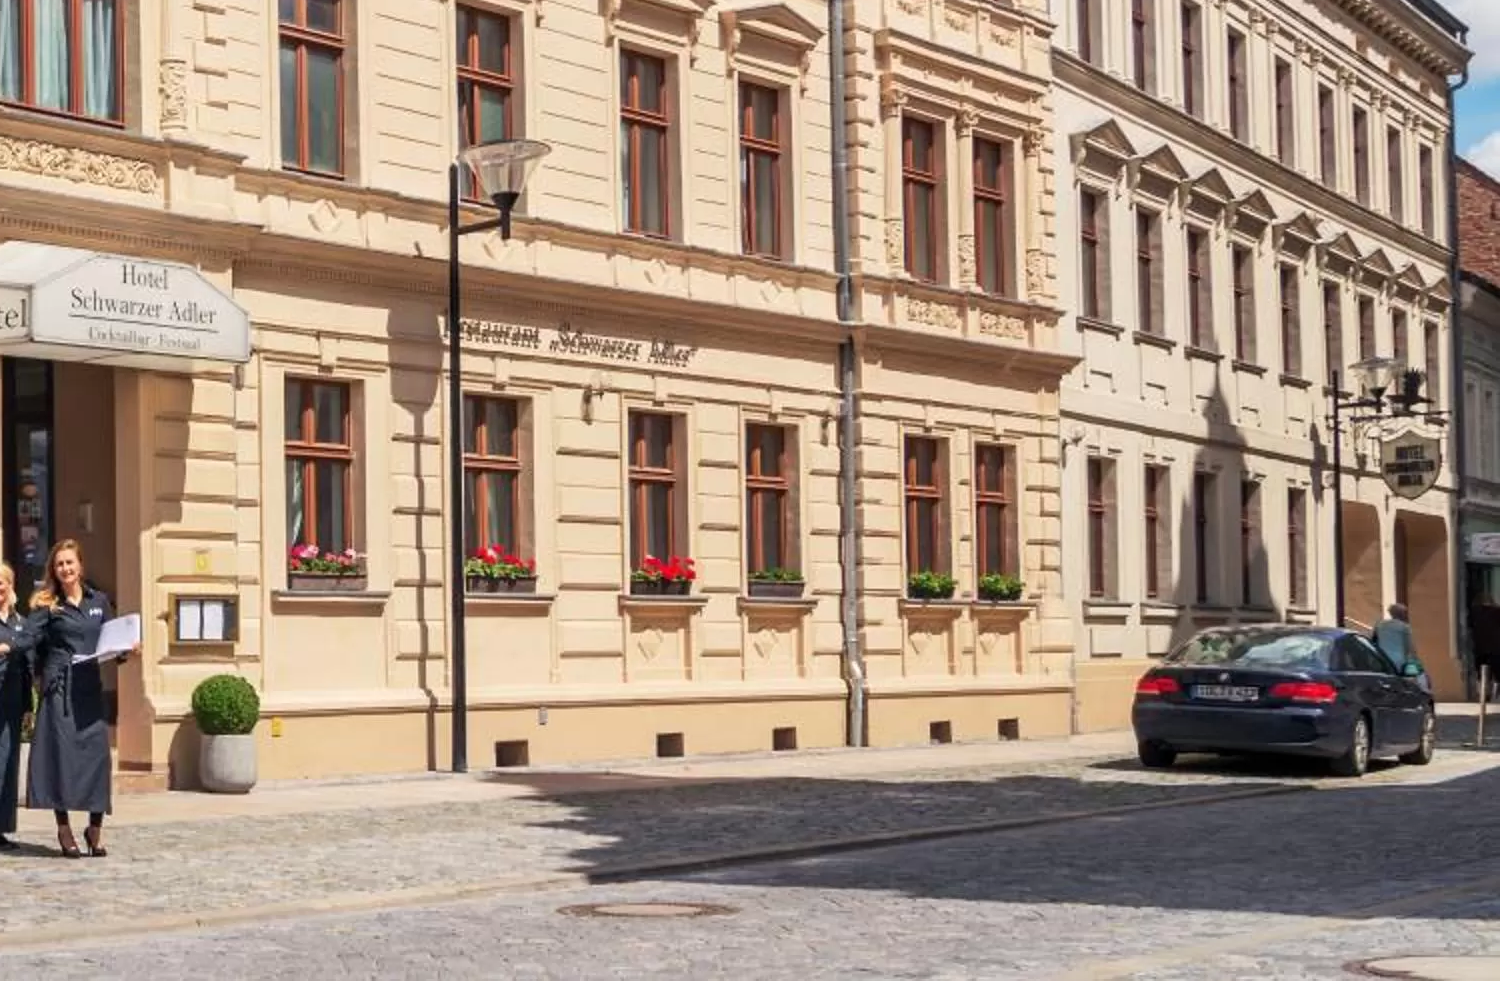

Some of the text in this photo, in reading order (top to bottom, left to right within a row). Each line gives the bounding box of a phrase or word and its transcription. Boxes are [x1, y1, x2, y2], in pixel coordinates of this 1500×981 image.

[121, 263, 169, 291] Hotel
[71, 287, 217, 324] Schwarzer Adler
